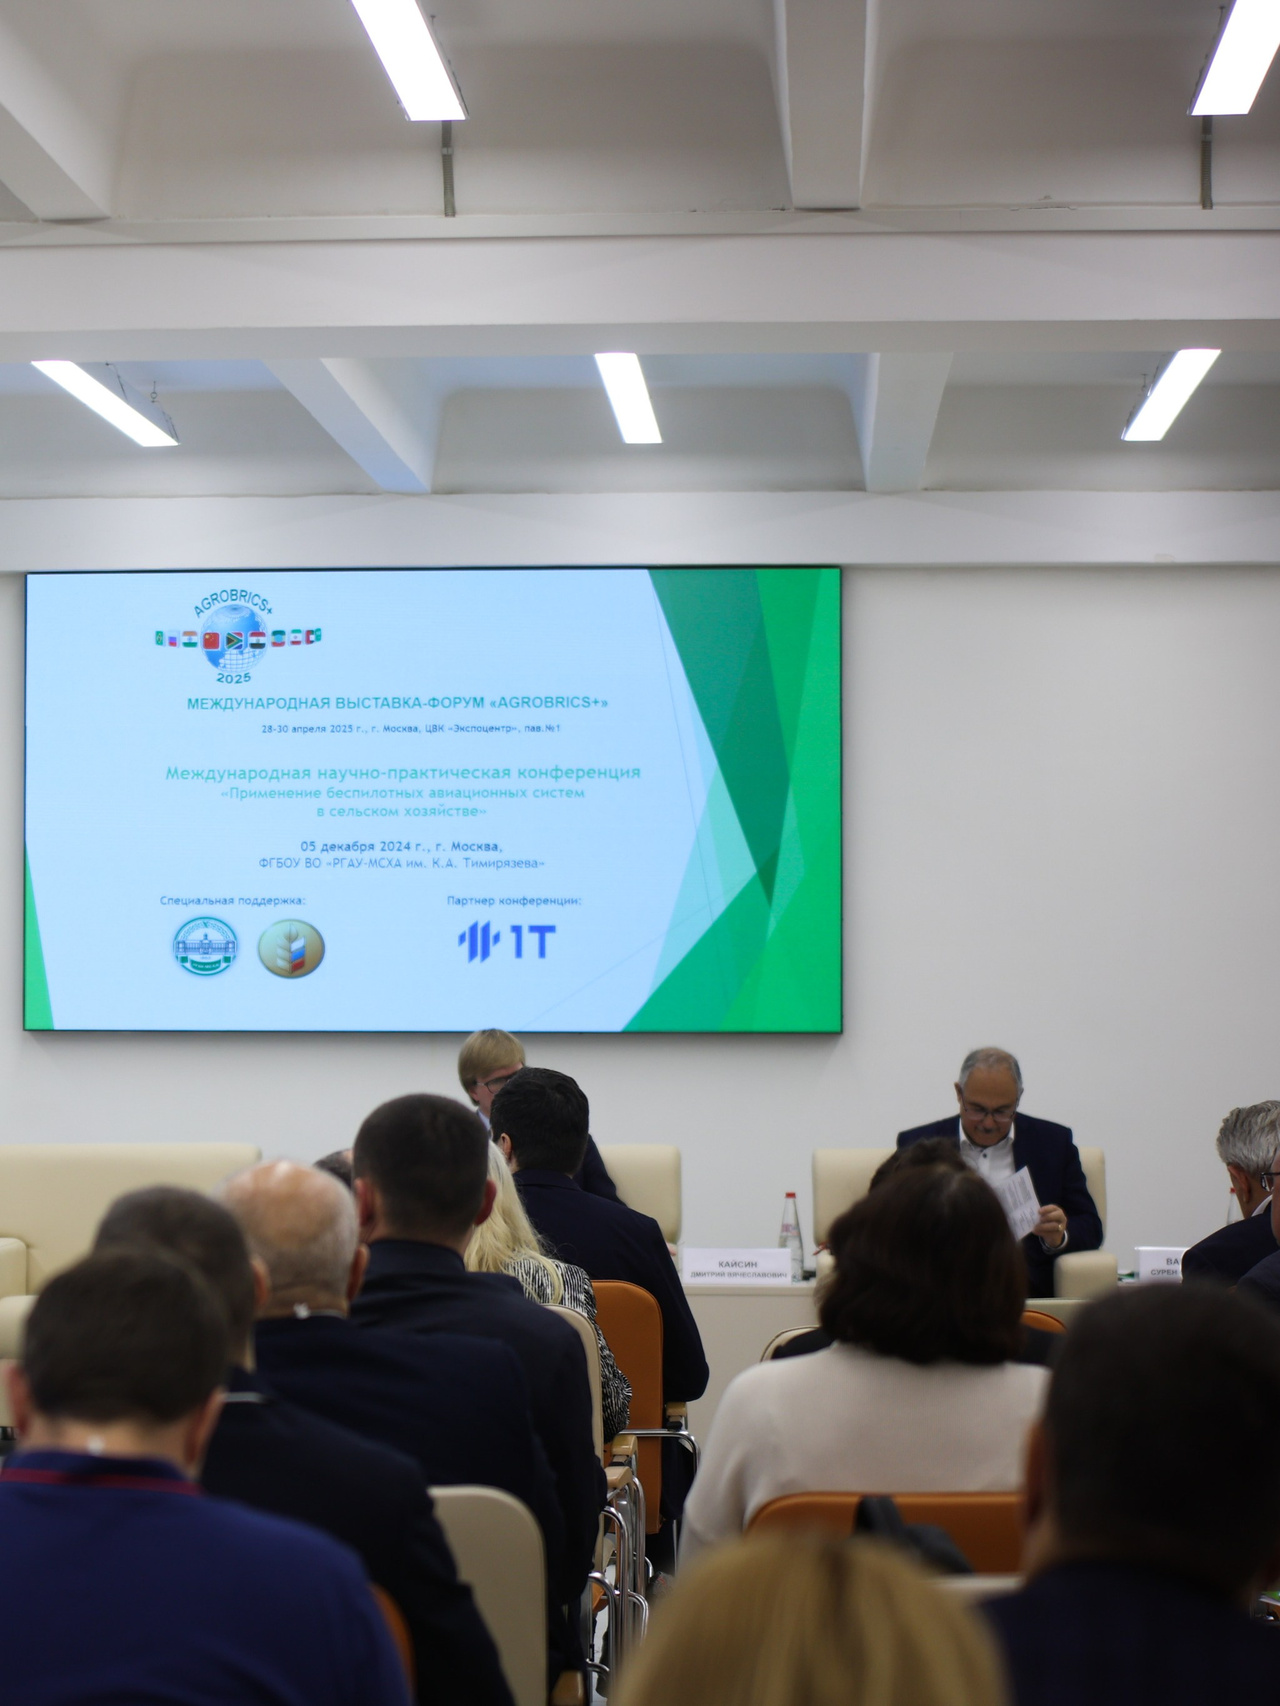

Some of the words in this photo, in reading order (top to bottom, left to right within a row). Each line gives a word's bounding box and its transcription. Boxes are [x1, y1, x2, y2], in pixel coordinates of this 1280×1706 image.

[194, 589, 273, 618] AGROBRICS+
[216, 672, 251, 684] 2025
[187, 698, 330, 711] МЕЖДУНАРОДНАЯ
[335, 696, 484, 709] ВЫСТАВКА-ФОРУМ
[490, 696, 608, 709] «AGROBRICS+»
[261, 725, 288, 733] 28-30
[291, 726, 326, 734] апреля
[330, 725, 353, 733] 2025
[383, 725, 421, 733] Москва,
[425, 724, 444, 734] ЦВК
[166, 767, 311, 783] Международная
[318, 768, 511, 783] научно-практическая
[518, 765, 641, 782] конференция
[220, 787, 321, 801] «Применение
[326, 787, 423, 799] беспилотных
[429, 788, 527, 801] авиационных
[533, 788, 585, 798] систем
[317, 807, 324, 817] в
[330, 807, 399, 817] сельском
[404, 804, 486, 817] хозяйстве»
[300, 841, 316, 852] 05
[320, 841, 374, 853] декабря
[380, 841, 411, 851] 2024
[415, 843, 431, 853] г.,
[436, 843, 446, 851] г.
[452, 841, 503, 853] Москва,
[259, 857, 300, 869] ФГБОУ
[305, 858, 321, 868] ВО
[326, 858, 402, 868] «РГАУ-МСХА
[406, 859, 426, 868] им.
[432, 857, 457, 868] К.А.
[463, 857, 545, 870] Тимирязева»
[160, 896, 234, 907] Специальная
[238, 897, 307, 907] поддержка:
[447, 896, 495, 907] Партнер
[499, 896, 582, 907] конференции:
[718, 1260, 757, 1268] КАЙСИН
